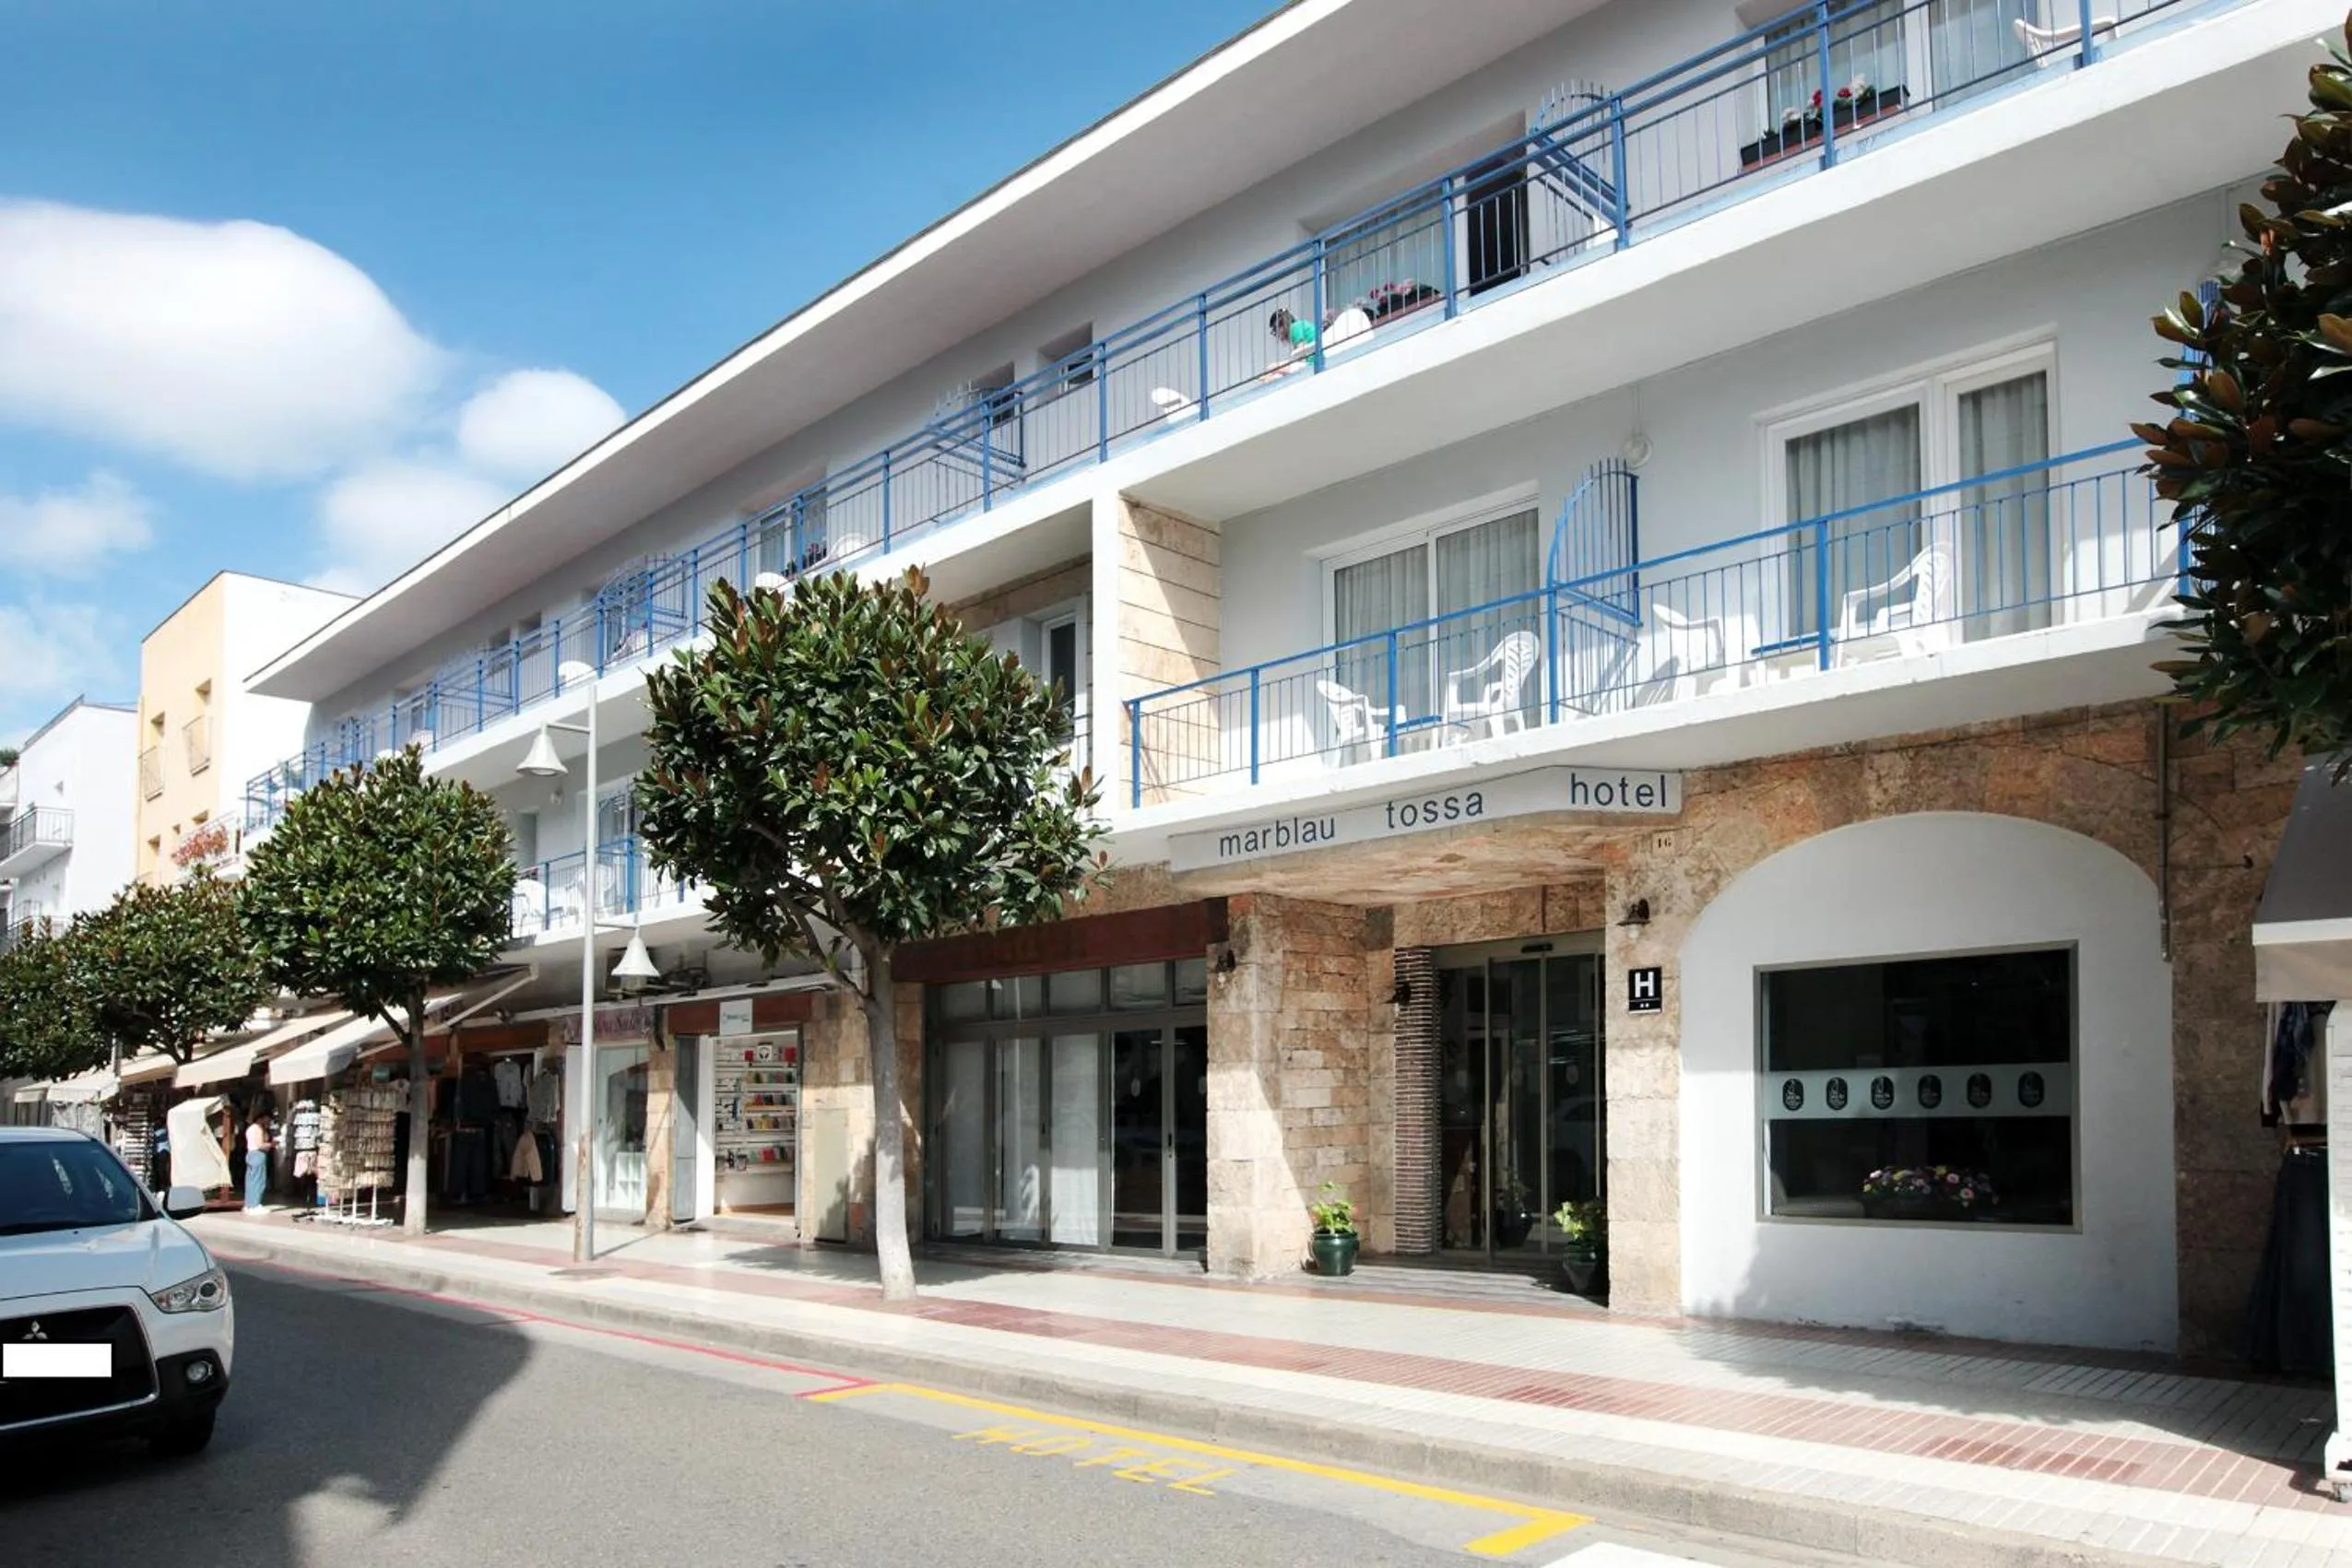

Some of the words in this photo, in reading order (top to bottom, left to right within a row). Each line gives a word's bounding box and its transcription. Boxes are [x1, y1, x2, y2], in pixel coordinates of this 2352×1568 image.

[1219, 818, 1335, 857] marblau
[1386, 792, 1483, 829] tossa
[1570, 773, 1666, 807] hotel
[1635, 972, 1654, 998] H
[952, 1424, 1238, 1495] HOTEL
